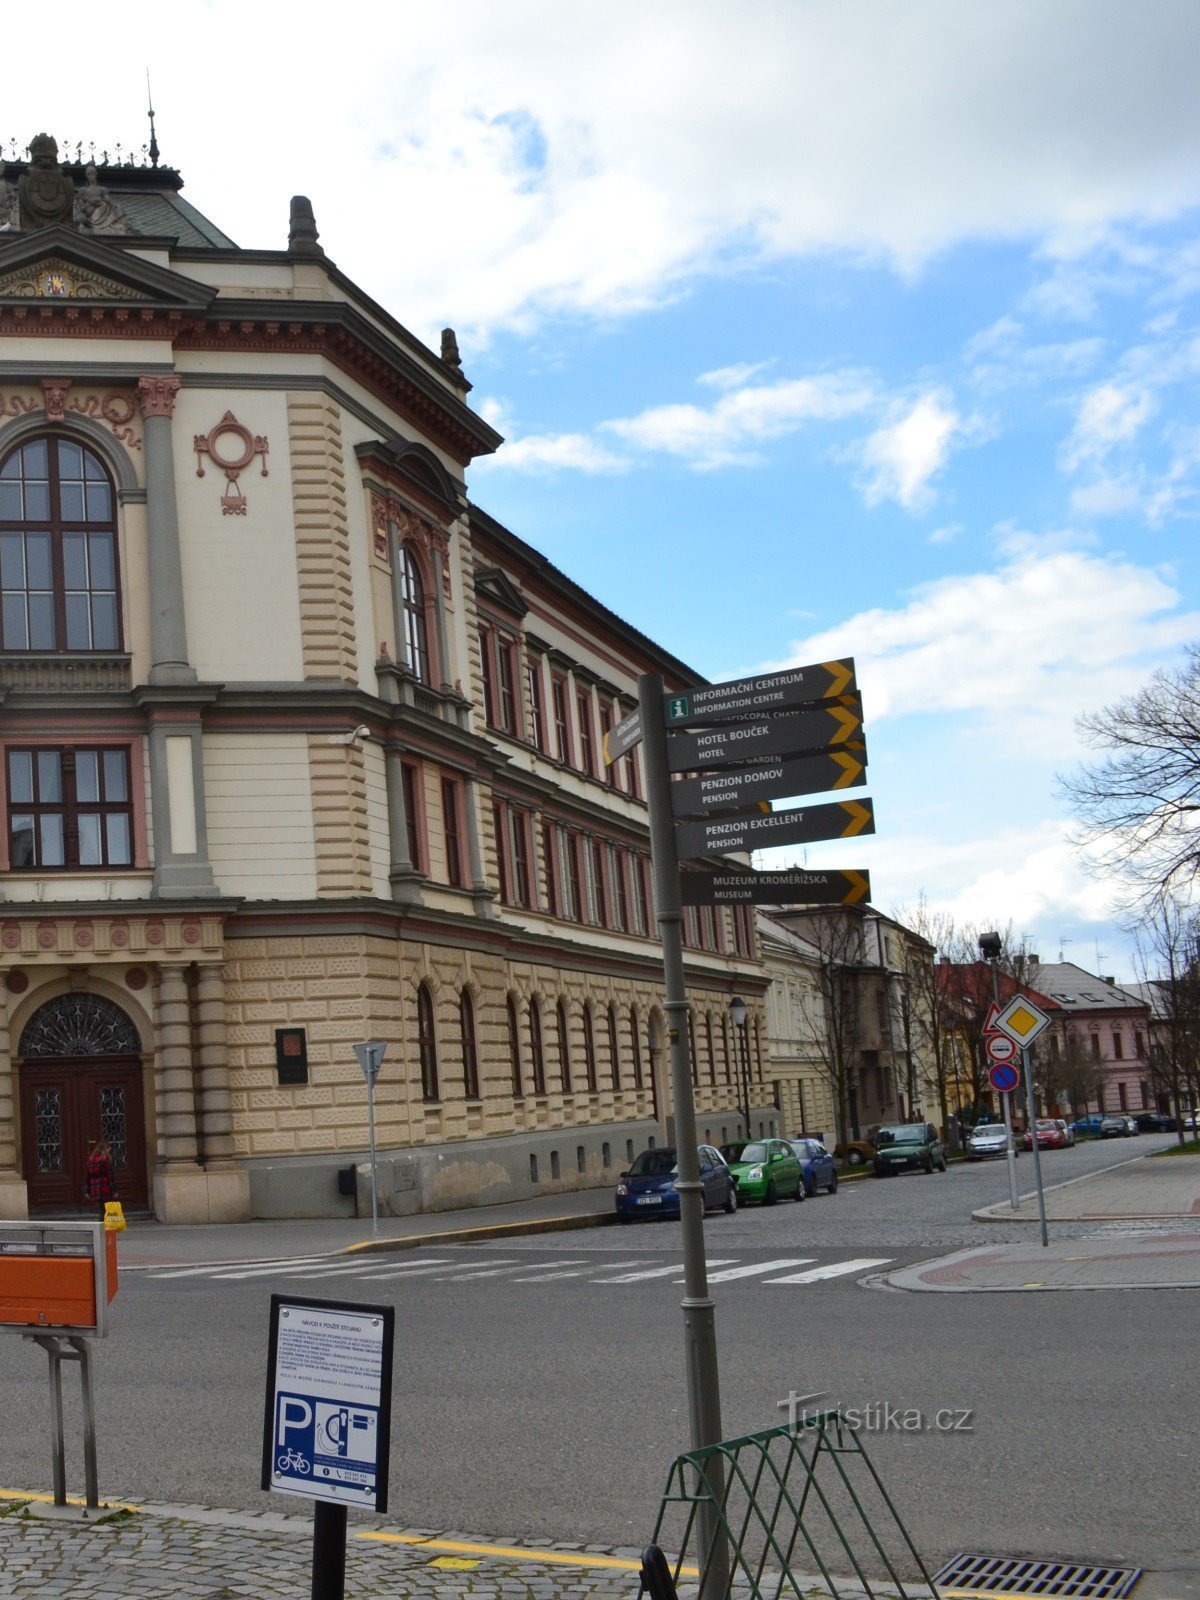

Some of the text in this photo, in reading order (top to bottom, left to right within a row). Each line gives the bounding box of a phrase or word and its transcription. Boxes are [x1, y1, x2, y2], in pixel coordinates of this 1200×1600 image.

[693, 673, 804, 702] INFORMAČNÍ CENTRUM
[694, 691, 784, 715] INFORMATION CENTRE
[697, 725, 770, 746] HOTEL BOUČEK
[698, 748, 725, 760] HOTEL
[701, 769, 784, 790] PENZION DOMOV
[702, 791, 738, 804] PENSION
[706, 813, 804, 836] PENZION EXCELLENT
[707, 837, 744, 849] PENSION
[713, 873, 828, 886] MUZEUM KROMĚŘÍŽSKA
[714, 891, 752, 899] MUSEUM
[278, 1396, 313, 1446] P
